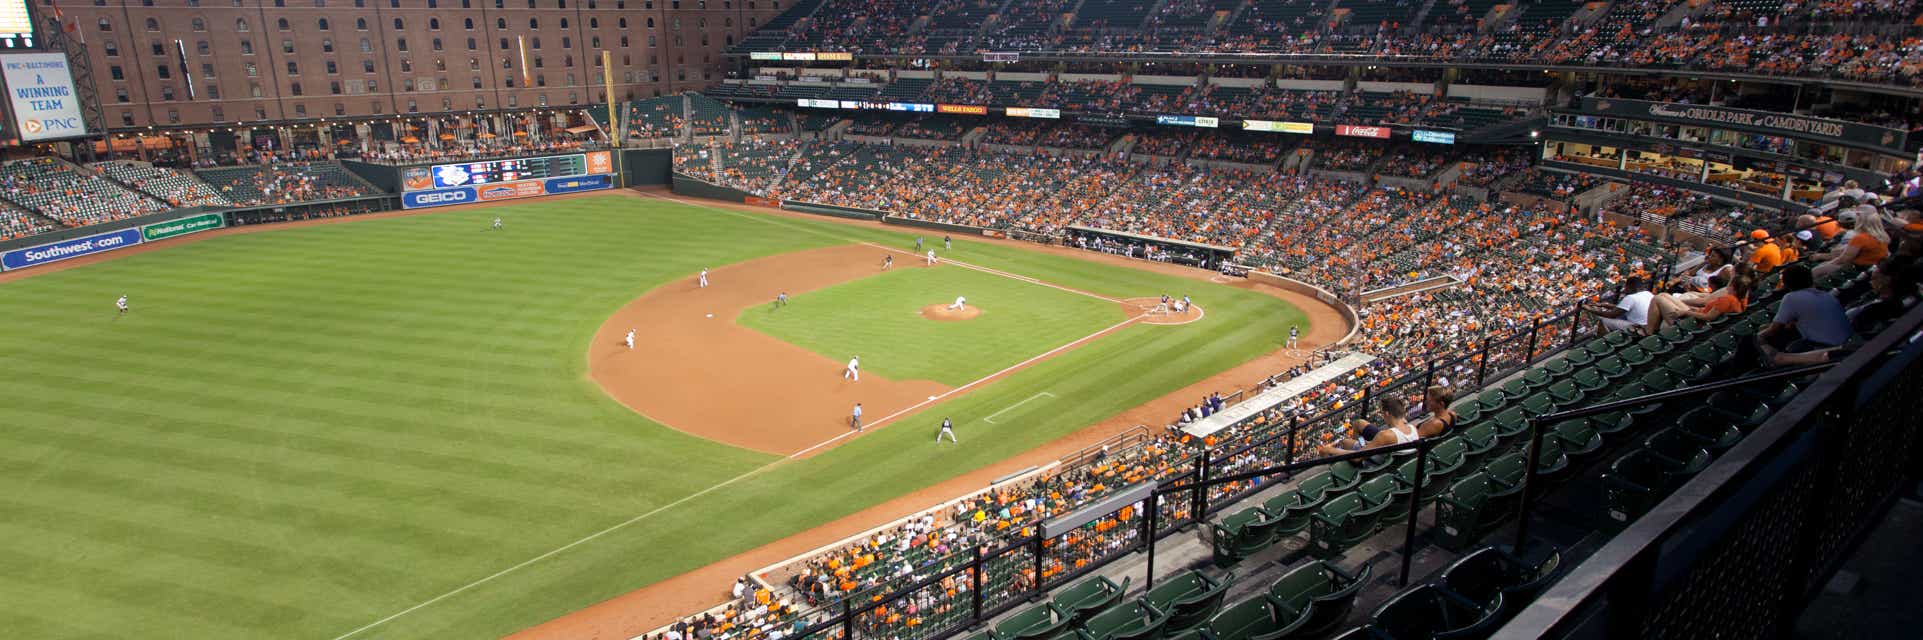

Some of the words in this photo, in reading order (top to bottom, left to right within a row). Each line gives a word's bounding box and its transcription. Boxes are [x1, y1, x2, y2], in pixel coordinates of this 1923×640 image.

[36, 74, 45, 85] A
[16, 86, 69, 98] WINNING
[30, 100, 63, 111] TEAM
[43, 117, 77, 130] PNC
[1686, 107, 1725, 122] ORIOLE
[1727, 112, 1755, 125] PARK
[1764, 116, 1811, 132] CAMDEN
[1810, 120, 1844, 136] YARDS
[416, 190, 467, 204] GEICO
[156, 223, 184, 235] National
